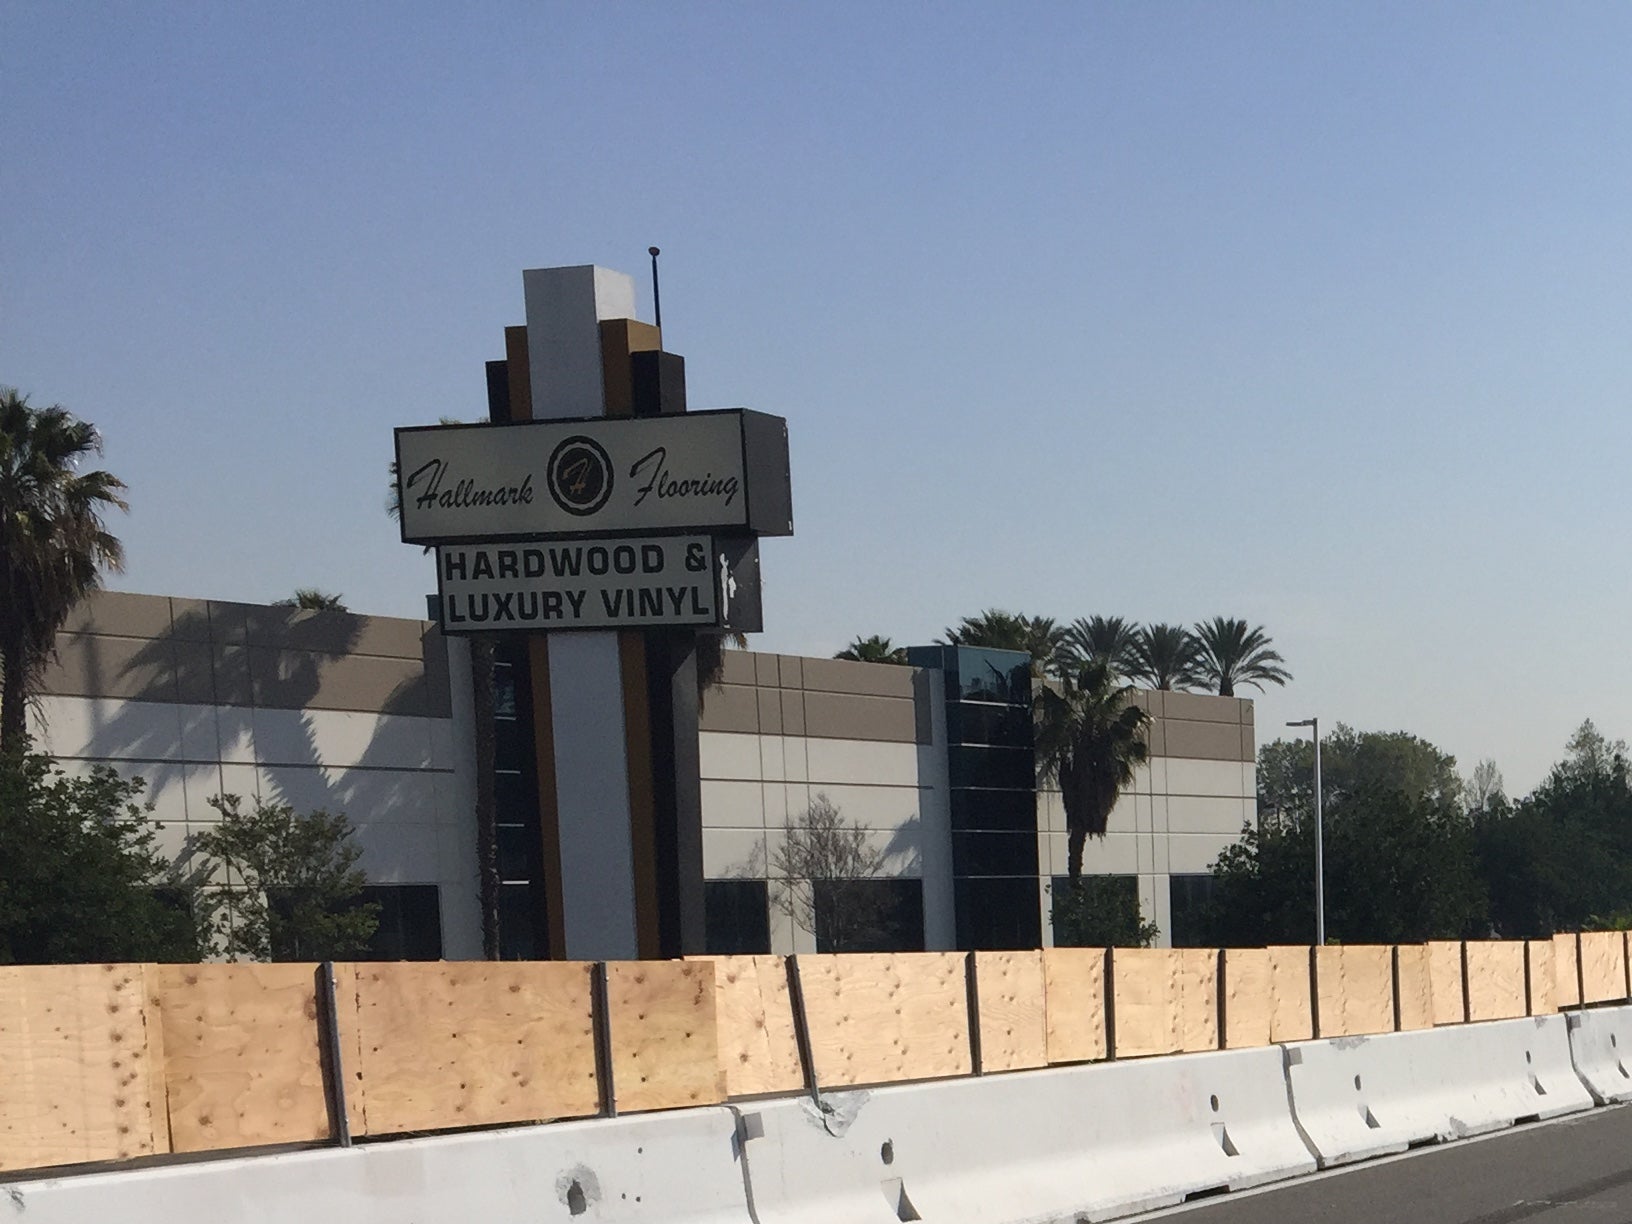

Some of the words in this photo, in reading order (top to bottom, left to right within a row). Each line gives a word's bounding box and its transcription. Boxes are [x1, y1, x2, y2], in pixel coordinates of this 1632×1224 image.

[406, 458, 534, 510] Hallmark
[629, 446, 738, 507] Flooring
[445, 544, 665, 581] HARDWOOD
[685, 542, 708, 572] &
[448, 590, 586, 623] LUXURY
[600, 586, 709, 619] VINYL
